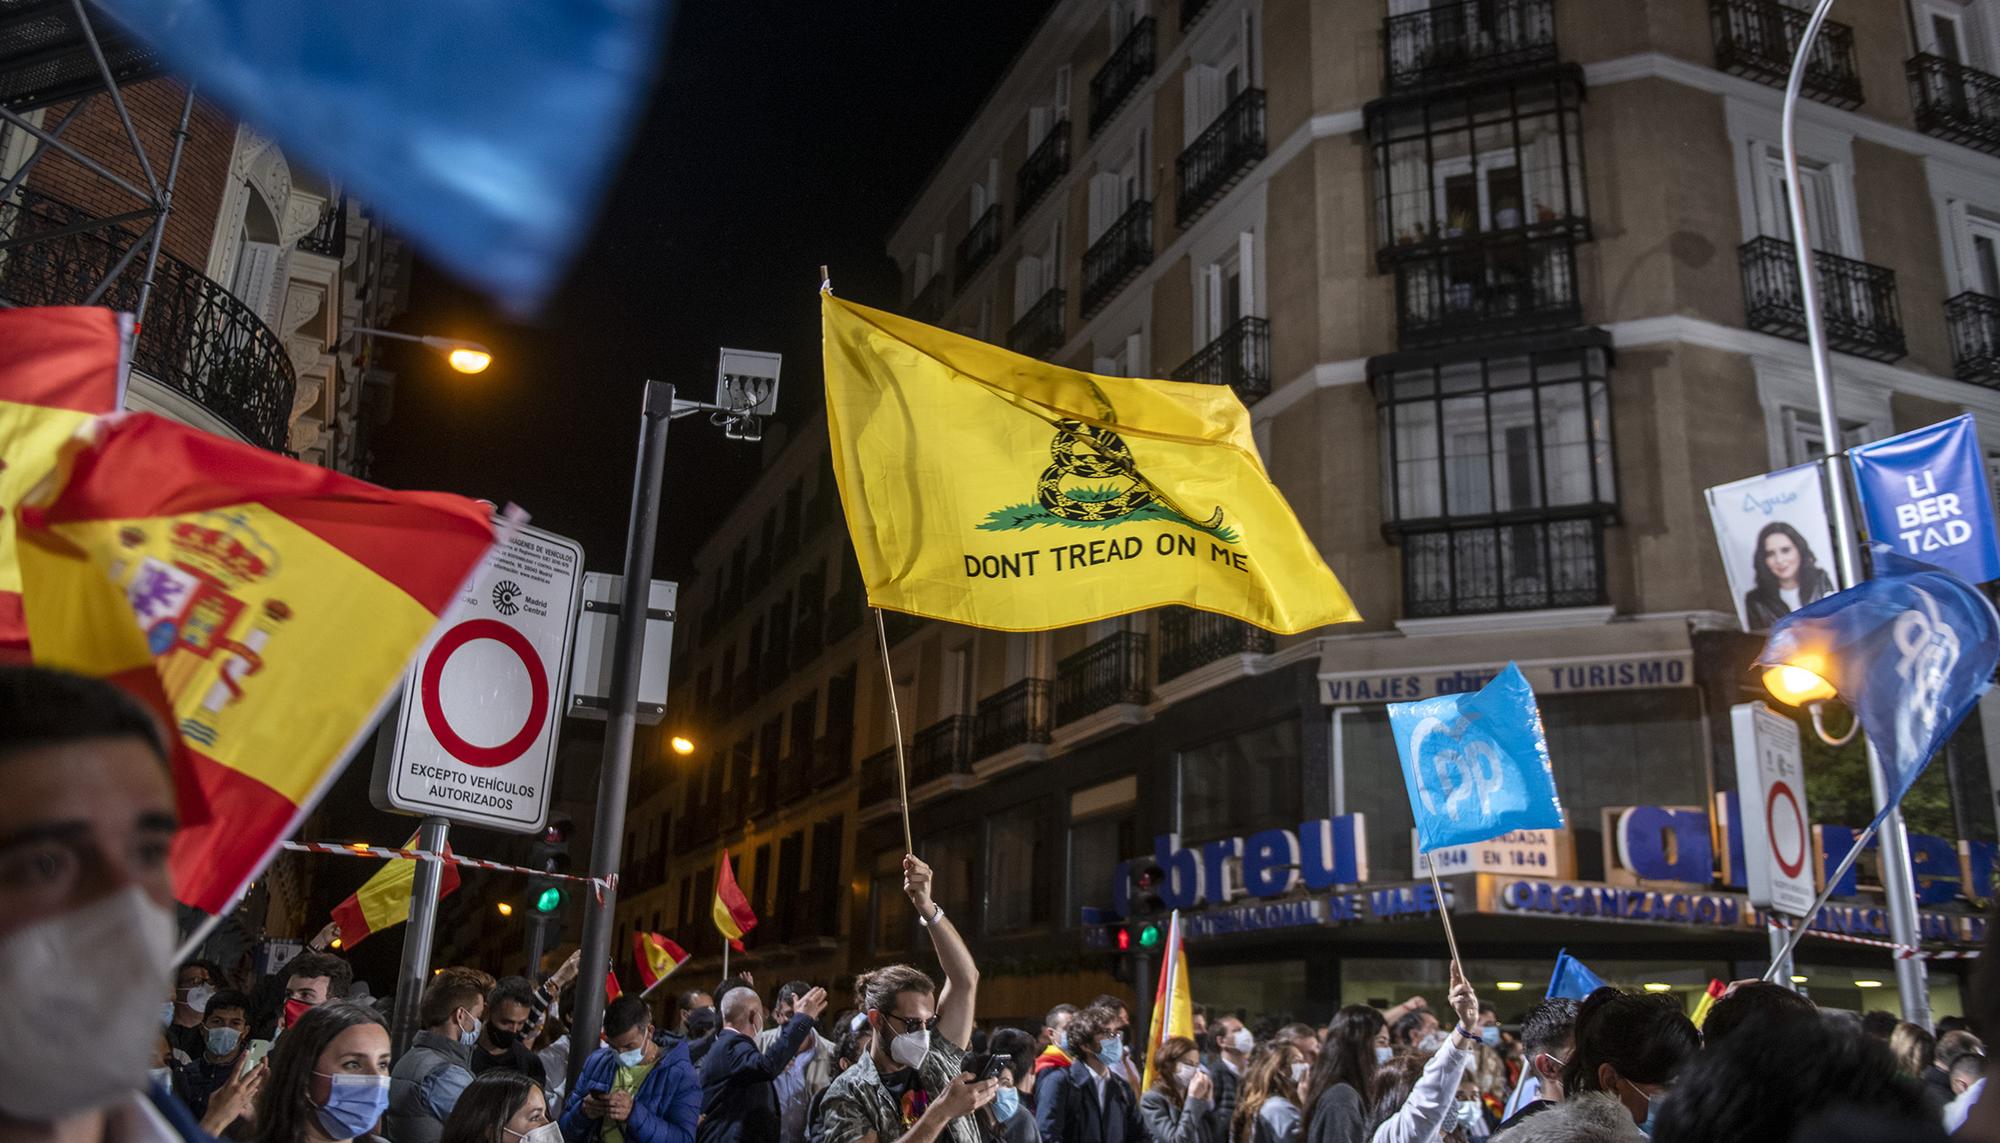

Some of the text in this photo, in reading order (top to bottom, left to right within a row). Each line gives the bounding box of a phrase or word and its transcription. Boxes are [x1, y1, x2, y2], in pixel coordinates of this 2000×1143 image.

[1906, 470, 1936, 498] LI
[1896, 492, 1963, 529] BER
[1899, 519, 1972, 555] TAD
[964, 533, 1249, 579] DONT TREAD ON ME
[523, 604, 547, 617] Central
[525, 595, 548, 609] Madrid
[1328, 675, 1420, 701] VIAJES
[1549, 659, 1685, 691] TURISMO
[410, 762, 535, 798] EXCEPTO VEHÍCULOS
[429, 785, 513, 811] AUTORIZADOS
